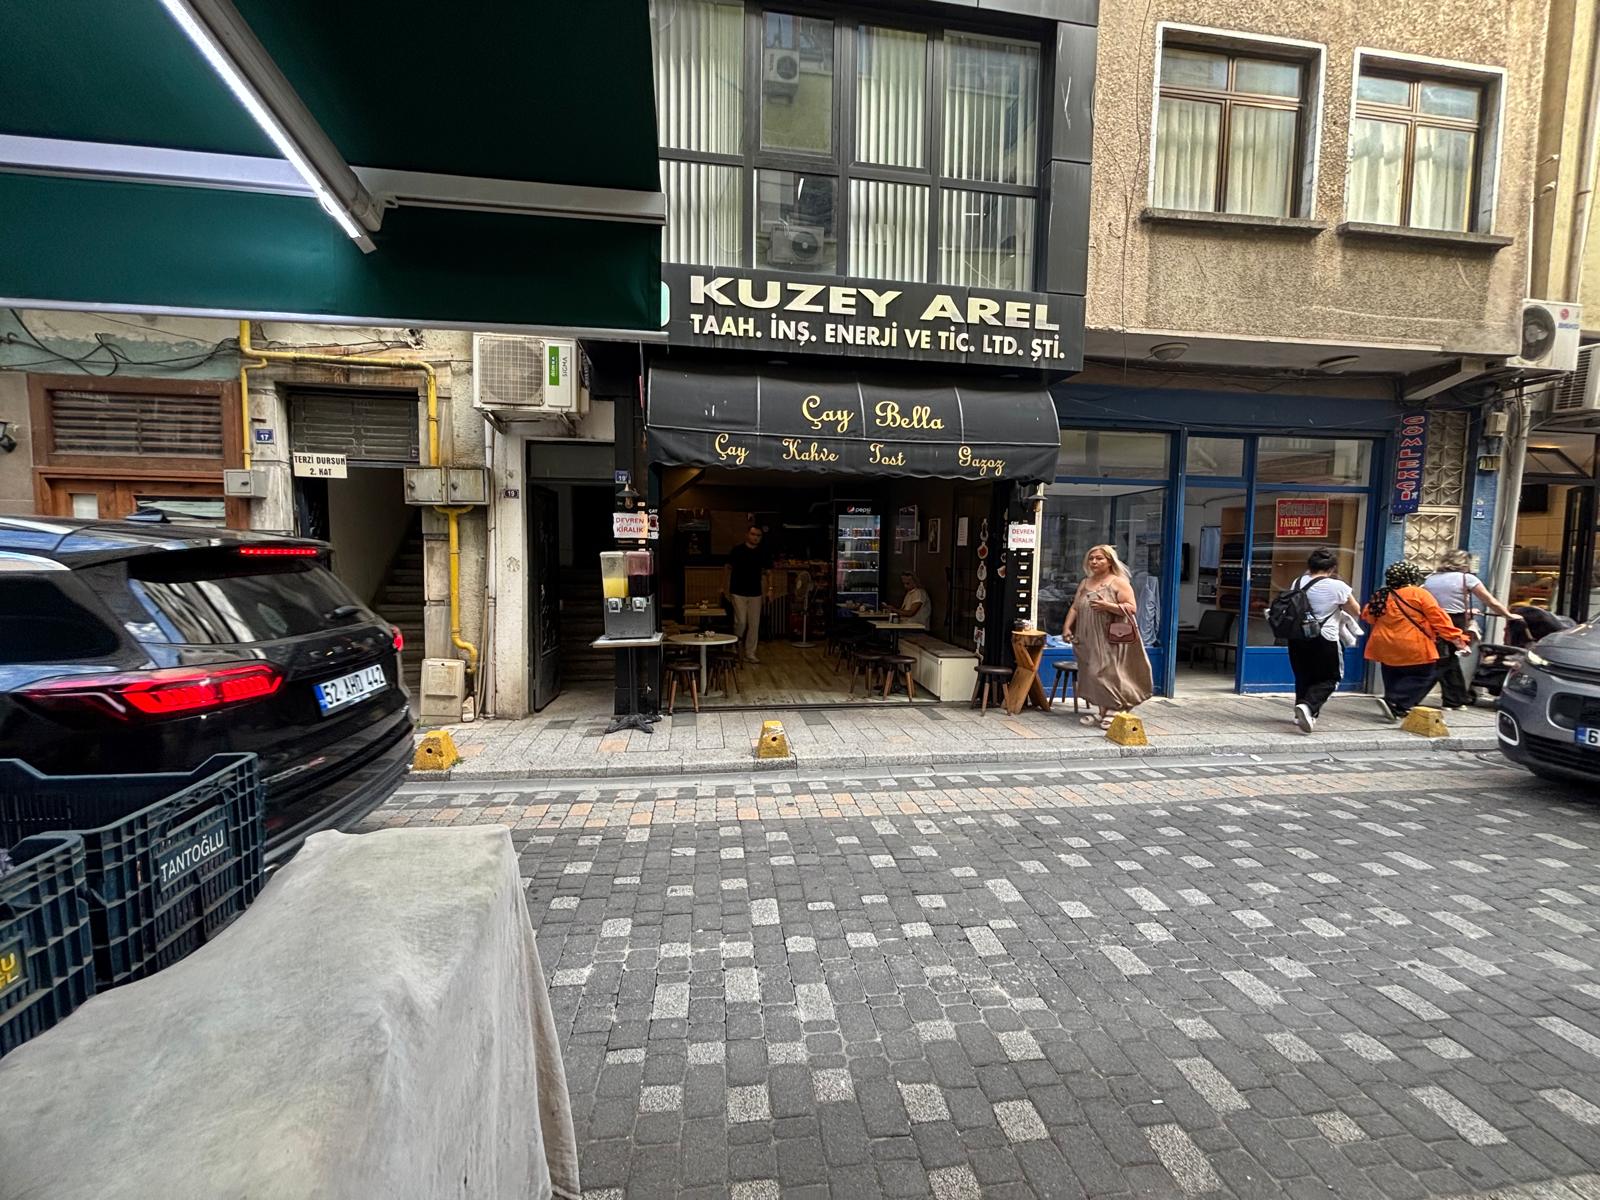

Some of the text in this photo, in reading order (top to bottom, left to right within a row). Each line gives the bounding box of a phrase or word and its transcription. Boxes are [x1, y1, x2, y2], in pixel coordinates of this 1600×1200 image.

[690, 275, 1060, 331] KUZEY AREL
[690, 313, 1065, 362] TAAH. İNŞ. ENERJİ VE TİC. LTD. ŞTİ.
[802, 395, 944, 433] Çay Bella
[260, 433, 269, 441] 17
[294, 455, 346, 465] TERZİ DURSUN
[715, 433, 1005, 476] Çay Kahve Tost Gazoz
[310, 468, 332, 476] 2. KAT
[617, 525, 644, 533] KİRALIK
[1302, 517, 1324, 527] AYVAZ
[1011, 535, 1034, 544] KİRALIK
[323, 682, 341, 705] 52
[365, 666, 384, 687] 442
[160, 829, 224, 882] TANTOĞLU
